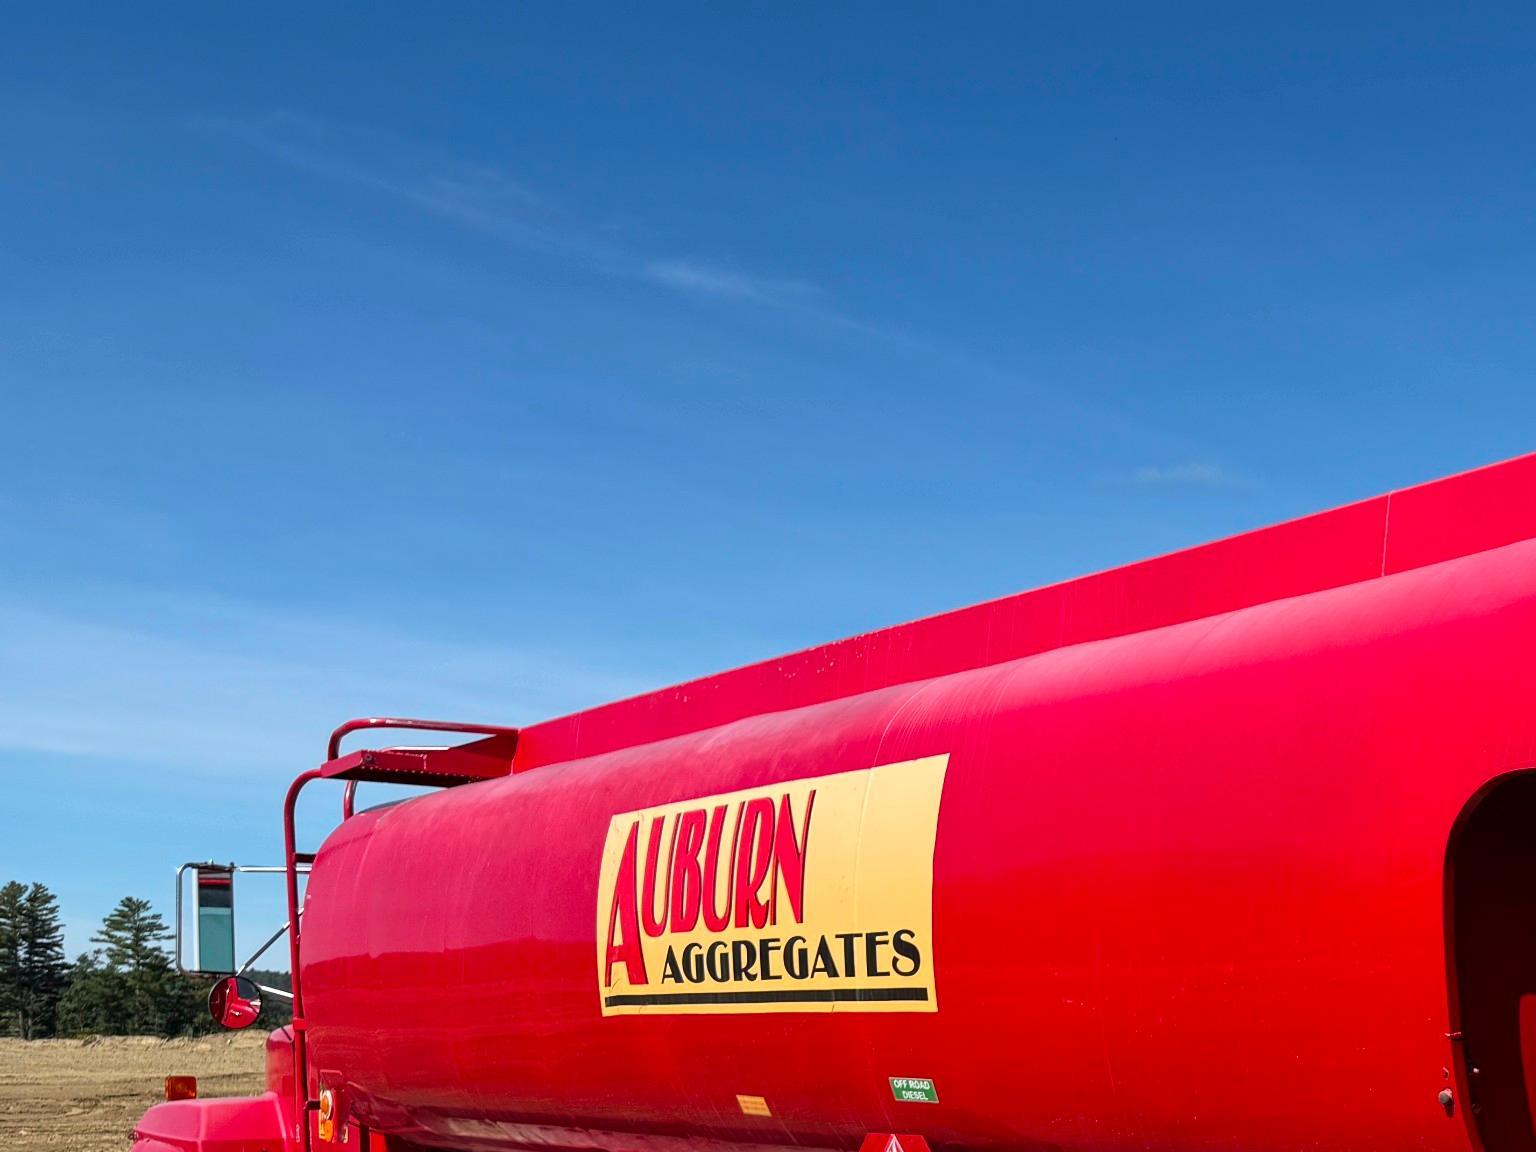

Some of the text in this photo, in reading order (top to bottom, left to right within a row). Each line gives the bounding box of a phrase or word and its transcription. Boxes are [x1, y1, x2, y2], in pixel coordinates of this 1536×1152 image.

[604, 789, 816, 988] AUBURN
[661, 929, 921, 984] AGGREGATES
[893, 1079, 930, 1090] OFF ROAD
[902, 1091, 928, 1100] DIESEL
